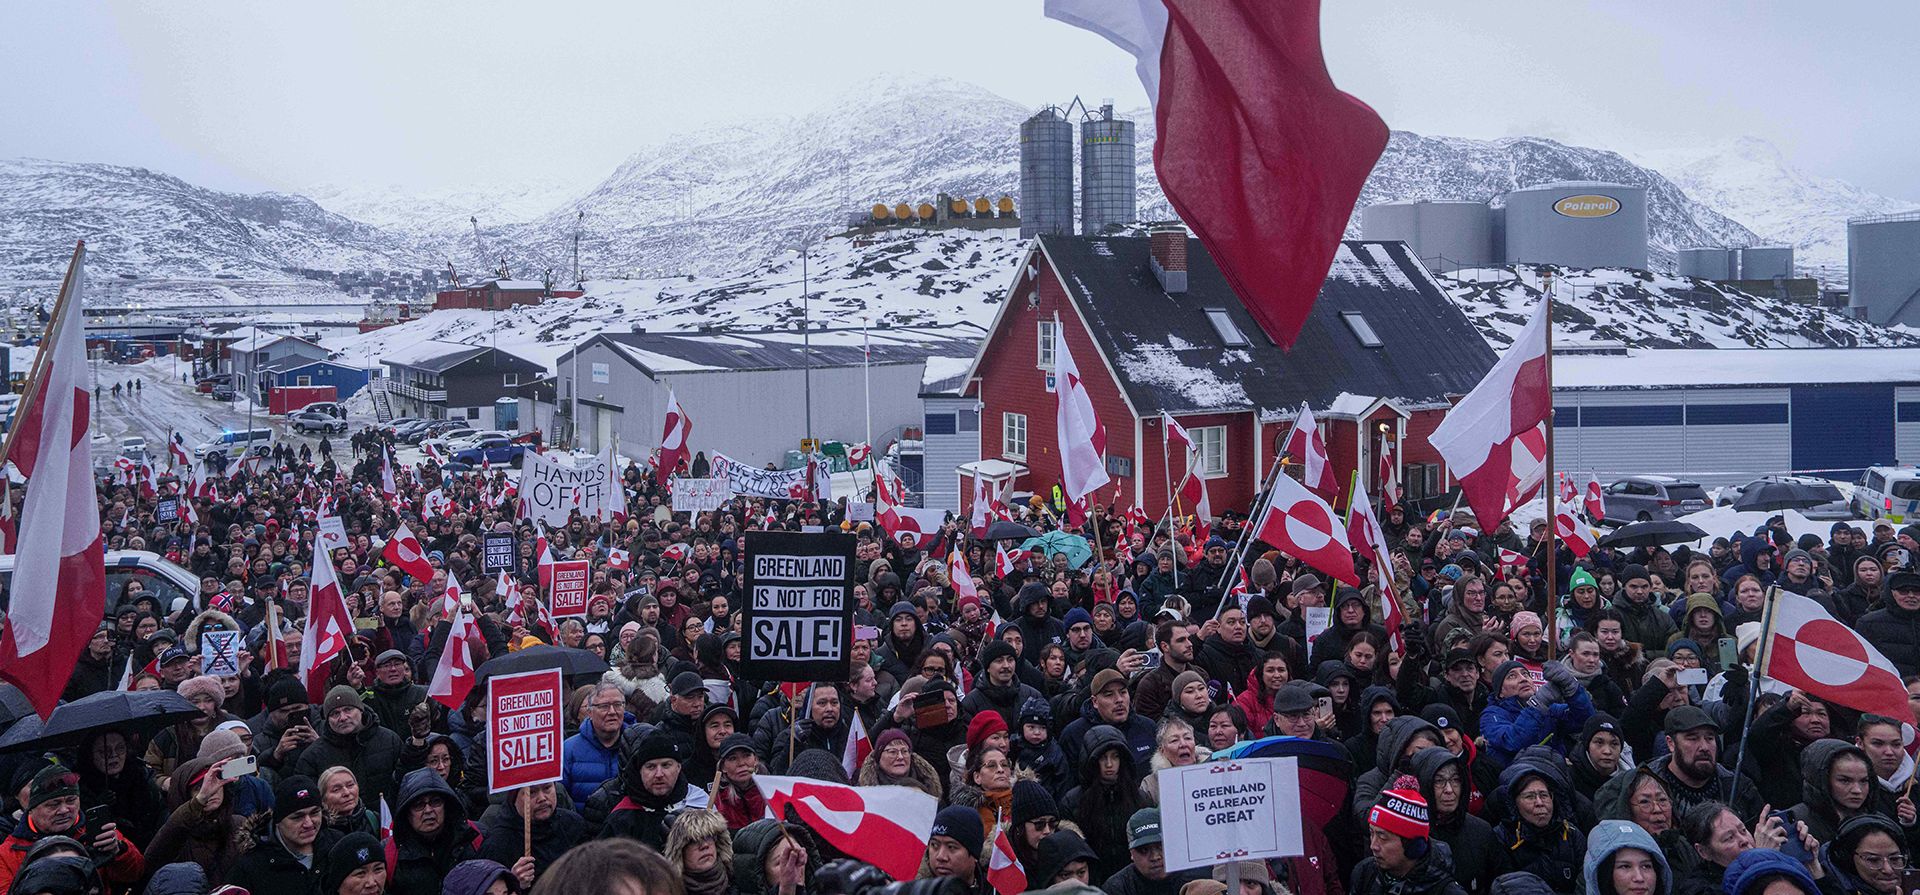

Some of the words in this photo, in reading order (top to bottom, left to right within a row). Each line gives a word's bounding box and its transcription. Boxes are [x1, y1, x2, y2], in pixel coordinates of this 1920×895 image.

[1564, 201, 1613, 211] Polaroil
[534, 462, 605, 483] HANDS
[729, 460, 750, 477] WE
[728, 471, 789, 498] FUTURE
[488, 555, 511, 567] SALE!
[757, 558, 842, 578] GREENLAND
[558, 571, 584, 579] GREENLAND
[563, 582, 573, 590] NOT
[575, 581, 584, 589] FOR
[557, 591, 583, 607] SALE!
[755, 588, 769, 608] IS
[777, 589, 806, 608] NOT
[813, 588, 841, 608] FOR
[754, 619, 840, 658] SALE!
[500, 691, 552, 712] GREENLAND
[500, 719, 509, 733] IS
[513, 715, 531, 731] NOT
[535, 712, 552, 727] FOR
[501, 733, 553, 768] SALE!
[1191, 782, 1267, 800] GREENLAND
[1194, 802, 1206, 813] IS
[1208, 795, 1266, 811] ALREADY
[1205, 809, 1255, 826] GREAT
